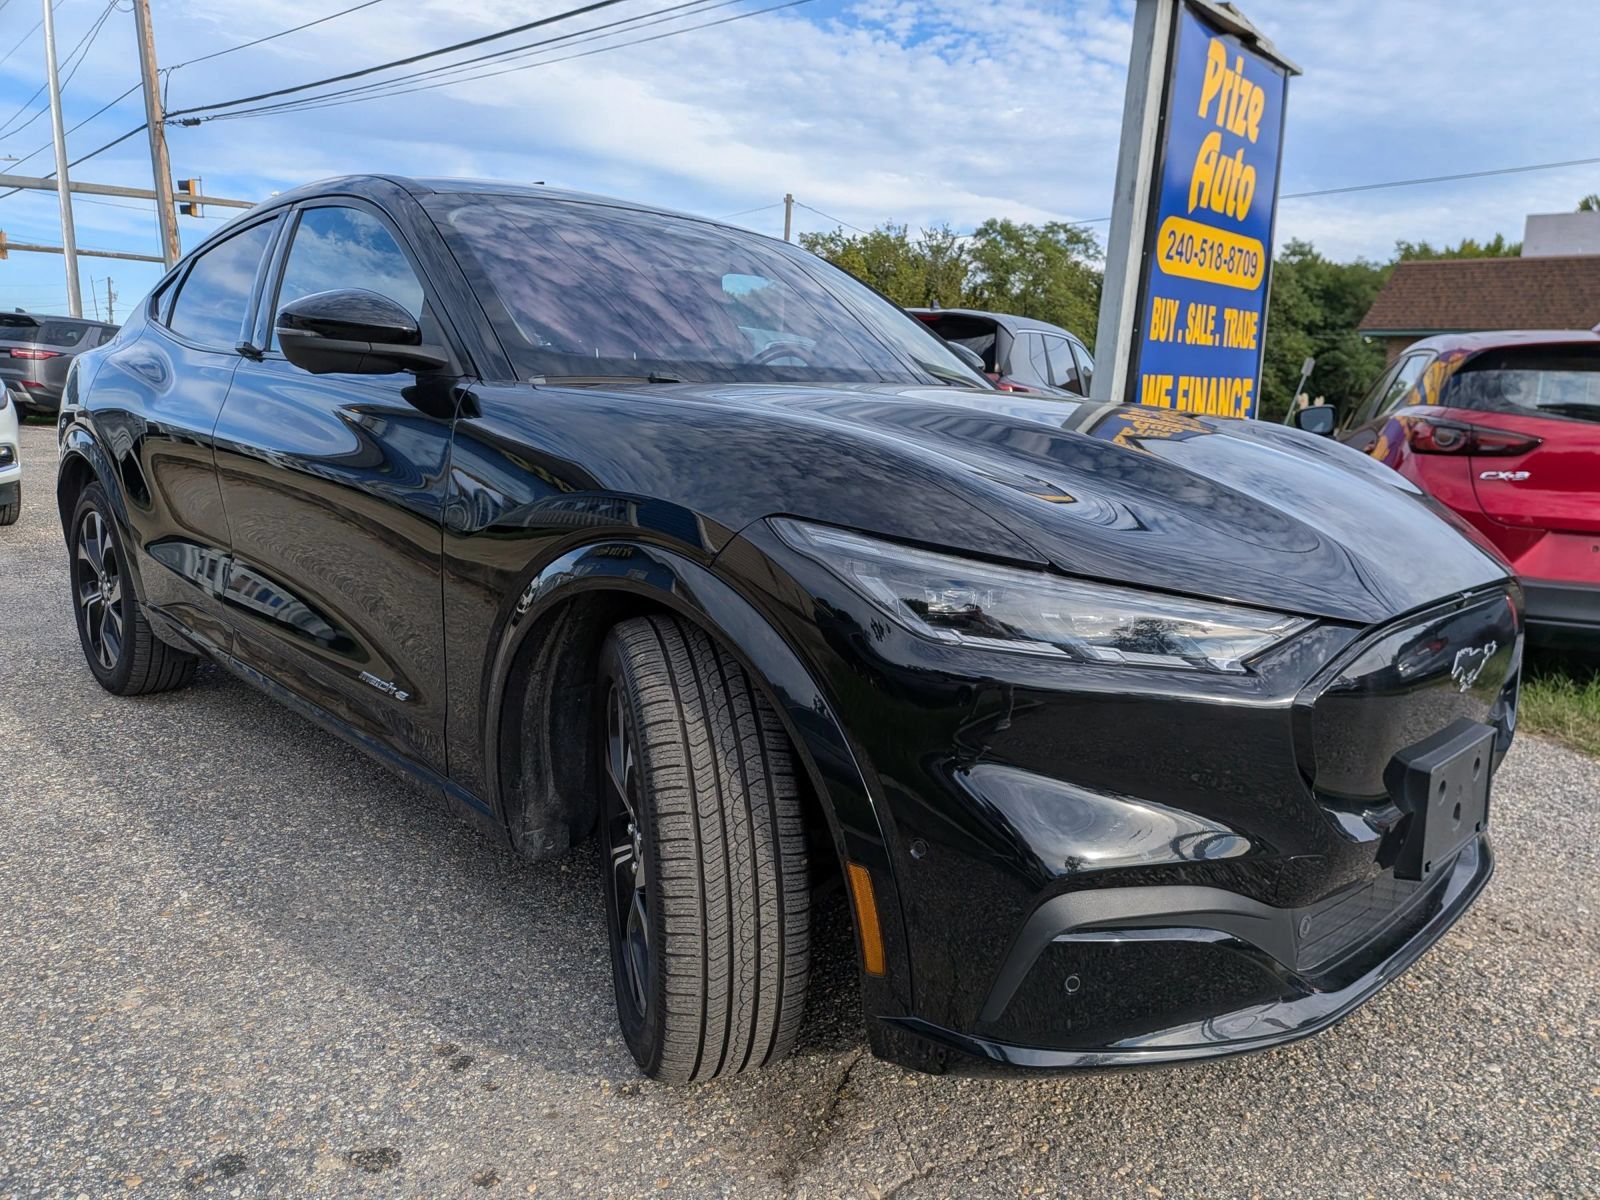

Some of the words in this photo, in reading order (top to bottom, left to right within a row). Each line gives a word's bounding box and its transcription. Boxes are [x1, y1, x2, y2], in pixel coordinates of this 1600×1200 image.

[1198, 37, 1265, 143] Prize
[1188, 131, 1257, 222] Auto
[1165, 229, 1258, 279] 240-518-8709
[1223, 308, 1259, 349] TRADE
[1141, 374, 1174, 408] WE
[1176, 375, 1253, 419] FINANCE
